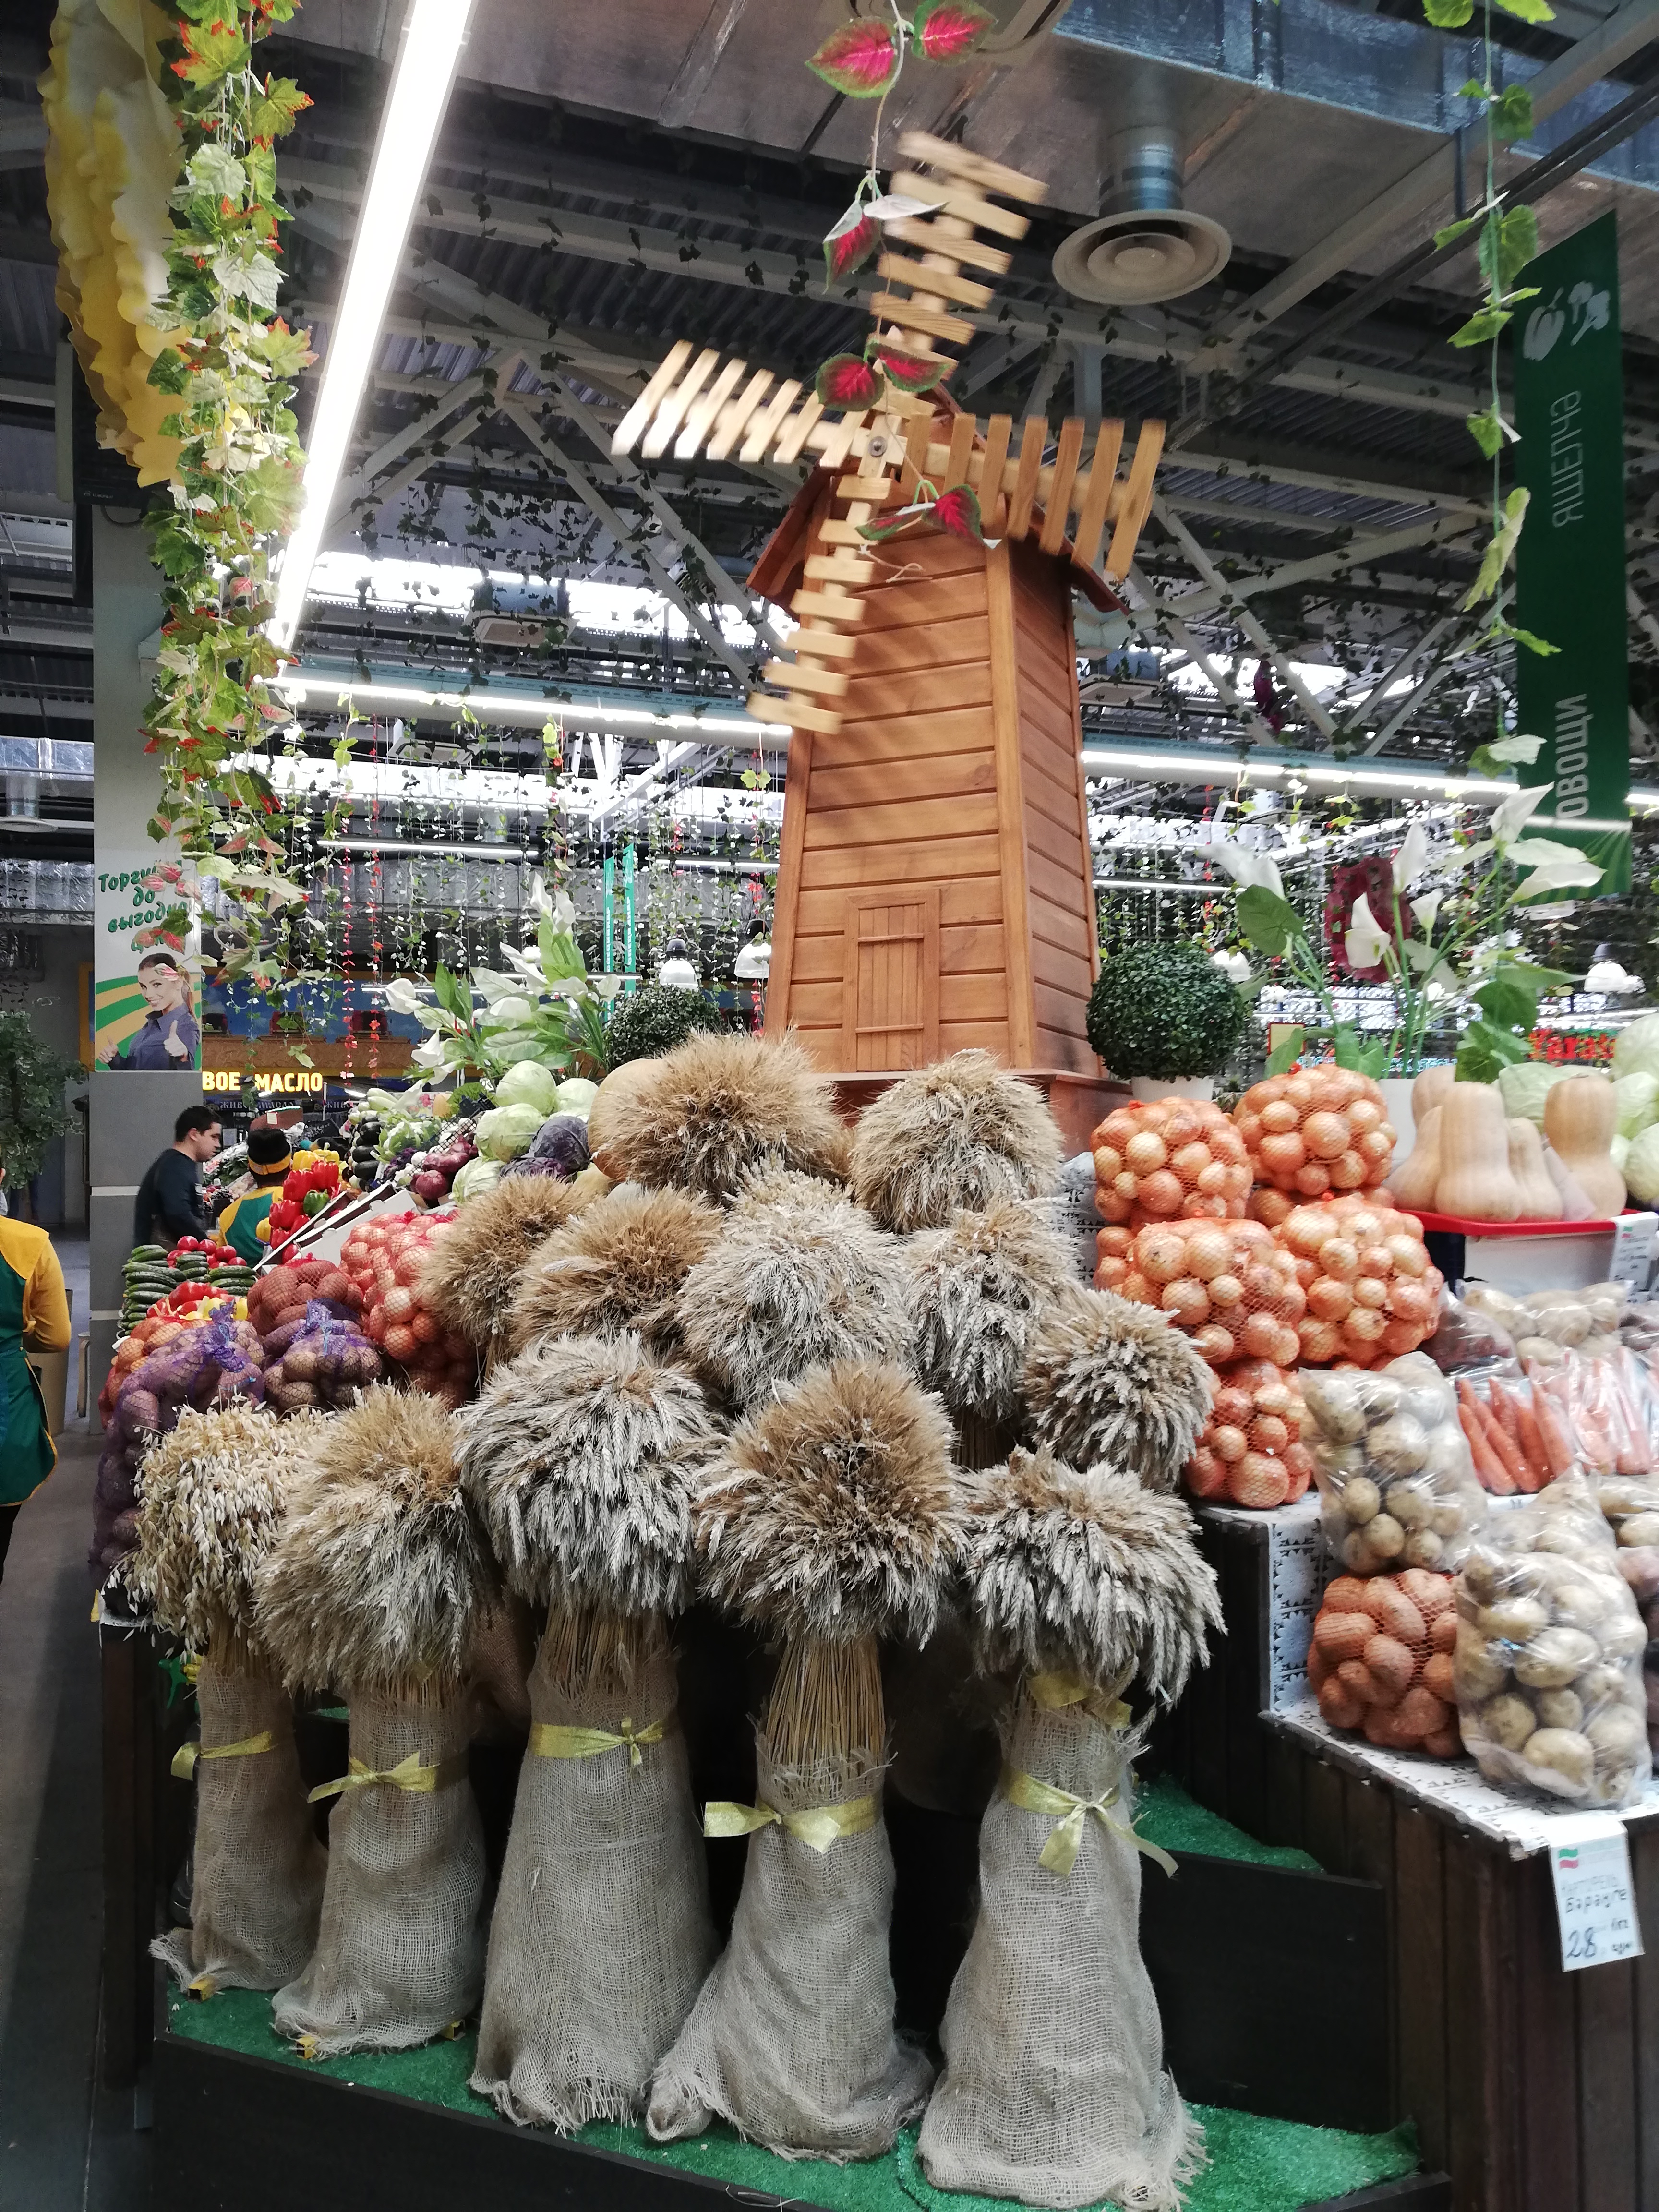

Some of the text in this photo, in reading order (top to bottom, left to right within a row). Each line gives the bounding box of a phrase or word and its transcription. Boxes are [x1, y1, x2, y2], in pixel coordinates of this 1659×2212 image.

[1555, 693, 1594, 819] ОВОЩИ
[133, 886, 155, 907] до
[254, 1072, 323, 1092] МАСЛО
[1566, 1927, 1597, 1958] 28
